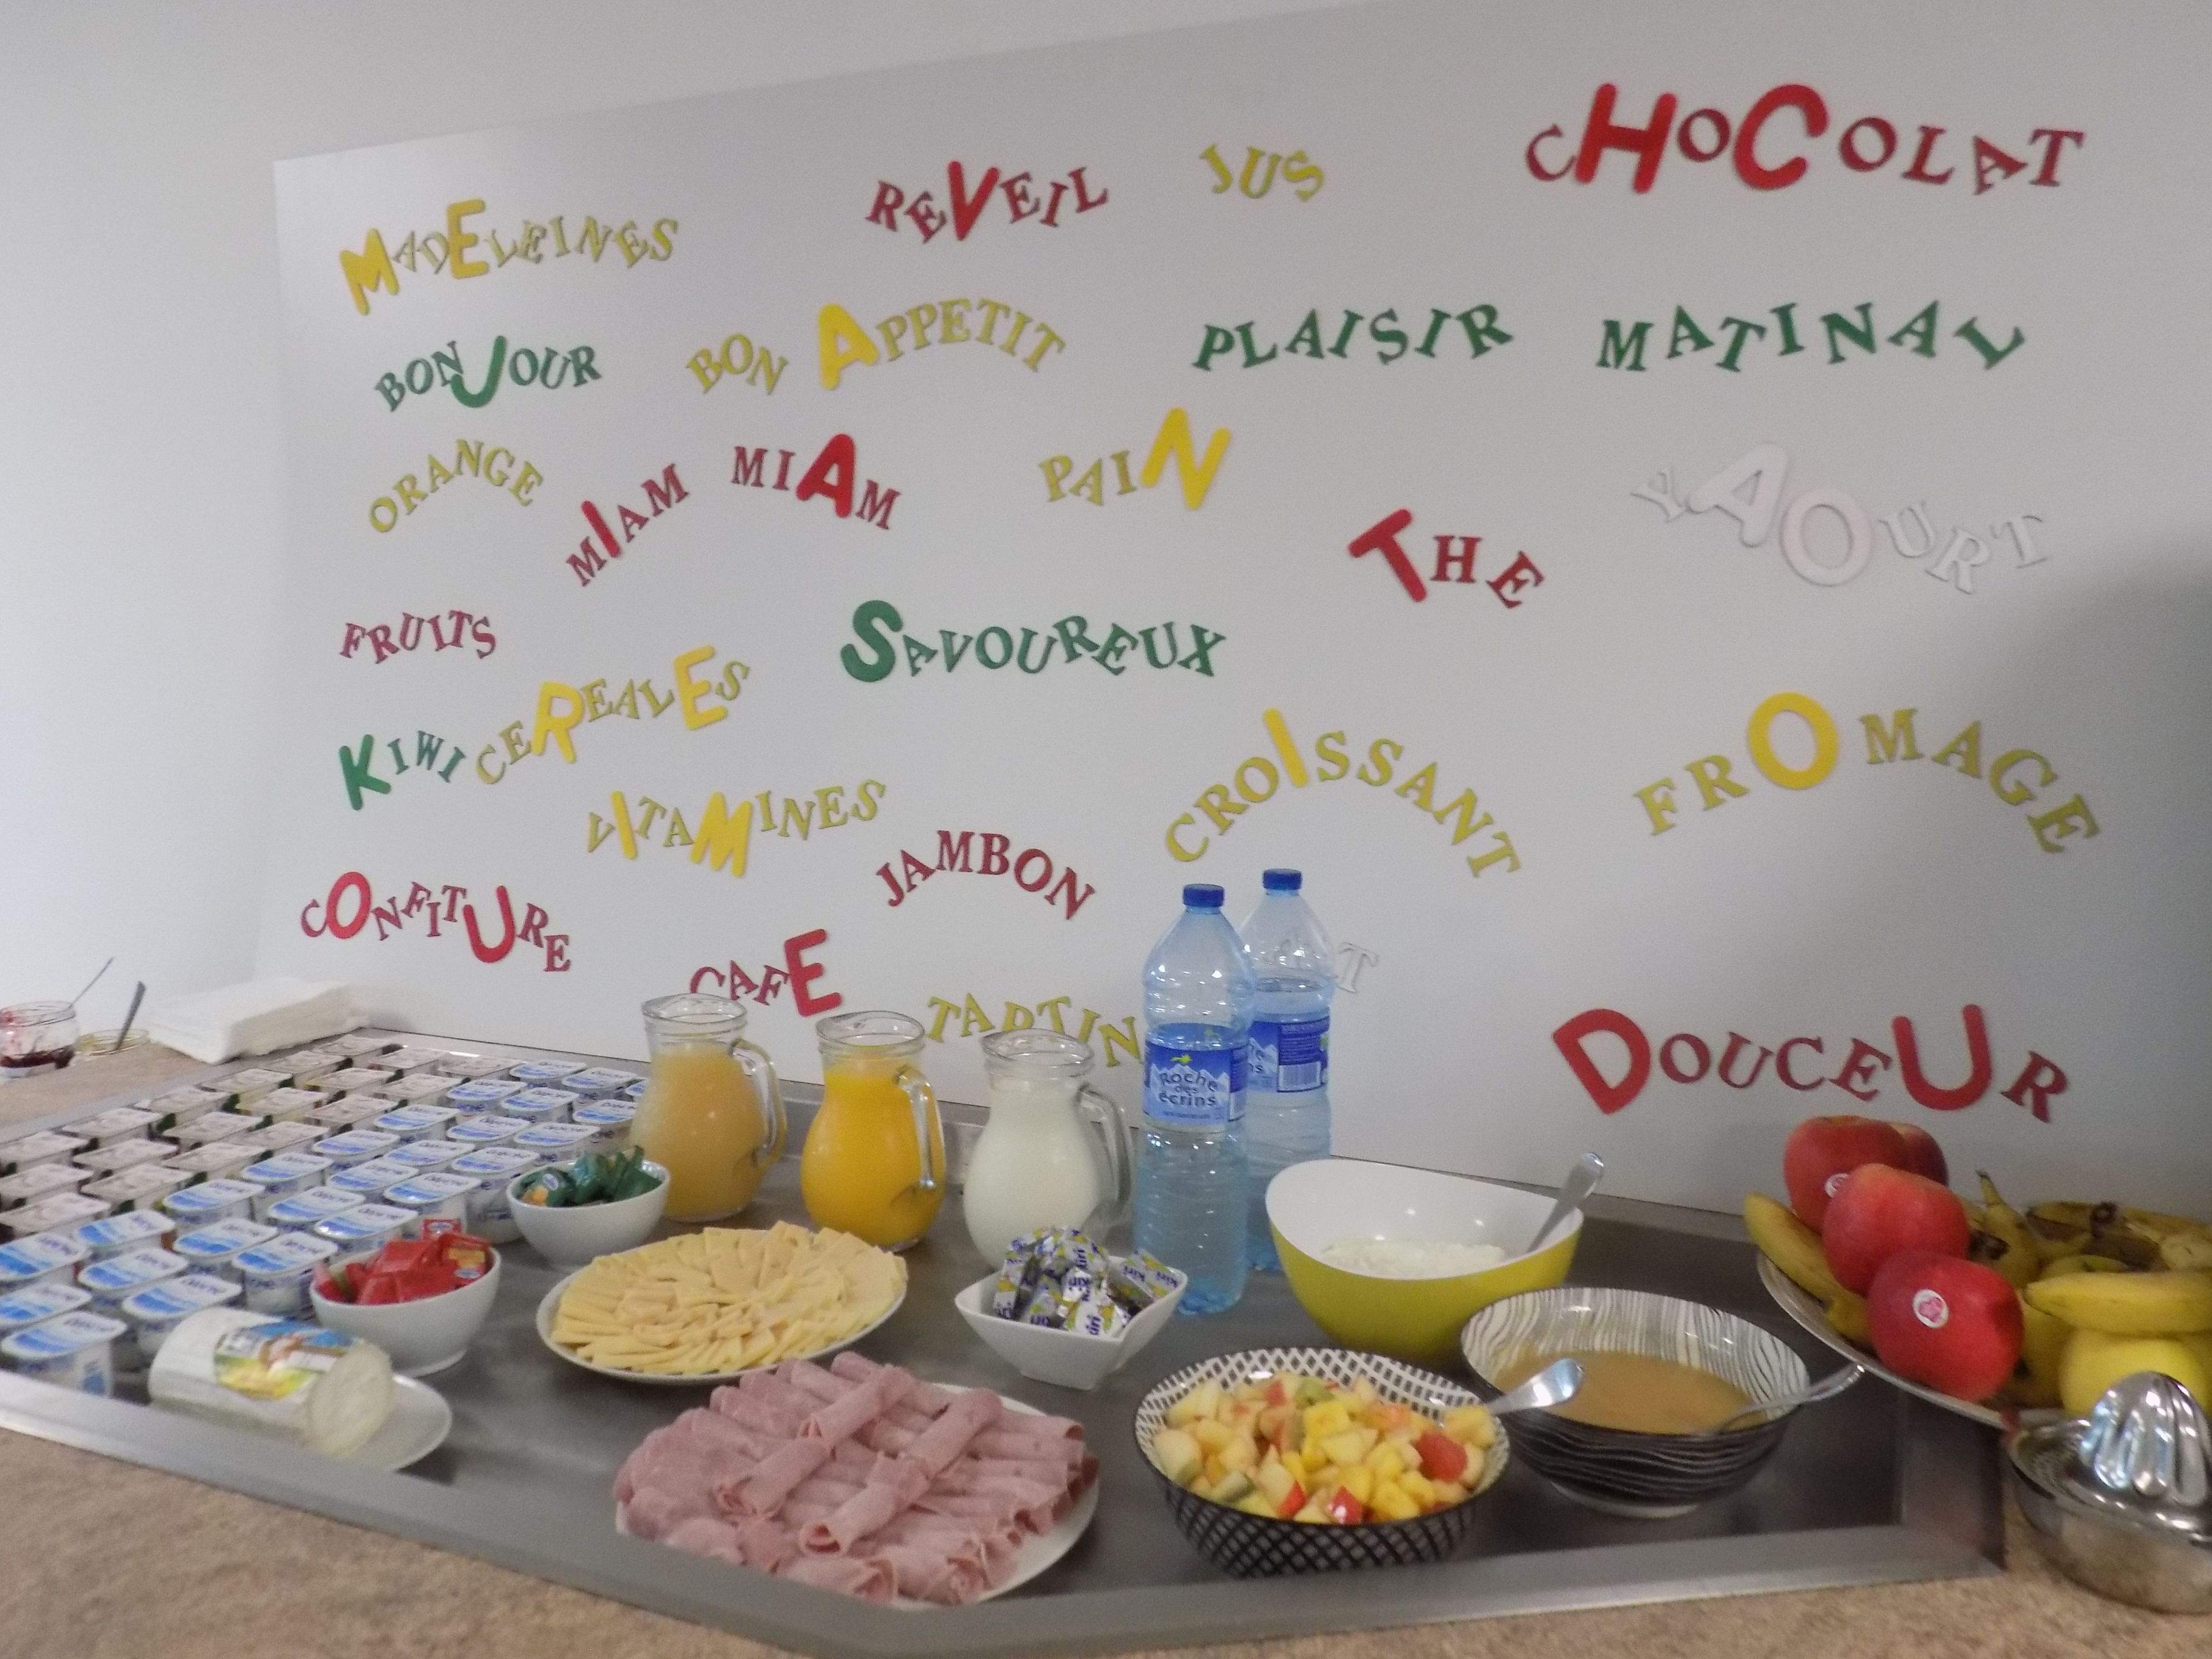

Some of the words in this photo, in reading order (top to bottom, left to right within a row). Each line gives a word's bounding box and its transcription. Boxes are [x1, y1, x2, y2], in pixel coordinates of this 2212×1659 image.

[1199, 143, 1324, 202] JUS
[1525, 83, 2084, 195] CHOCOLAT
[865, 161, 1108, 244] REVEIL
[339, 199, 678, 316] MADELEINES
[374, 335, 602, 412] BONJOUR
[686, 334, 789, 395] BON
[817, 297, 1066, 391] APPETIT
[1191, 303, 1514, 371] PLAISIR
[1596, 300, 2025, 372] MATINAL
[369, 439, 543, 533] ORANGE
[1038, 407, 1232, 510] PAIN
[566, 463, 690, 587] MIAM
[731, 433, 902, 530] MIAM
[1347, 508, 1544, 608] THE
[1630, 442, 2047, 594] YAOURT
[339, 609, 497, 664] FRUITS
[840, 600, 1226, 683] SAVOUREUX
[475, 645, 749, 785] CEREALES
[338, 734, 466, 810] KIWI
[1165, 707, 1521, 878] CROISSANT
[1633, 691, 2100, 854] FROMAGE
[587, 779, 886, 878] VITAMINES
[876, 830, 1096, 920] JAMBON
[300, 872, 571, 972] CONFITURE
[690, 928, 842, 1017] CAFE
[927, 993, 1143, 1067] TARTIN
[1552, 1003, 2069, 1123] DOUCEUR
